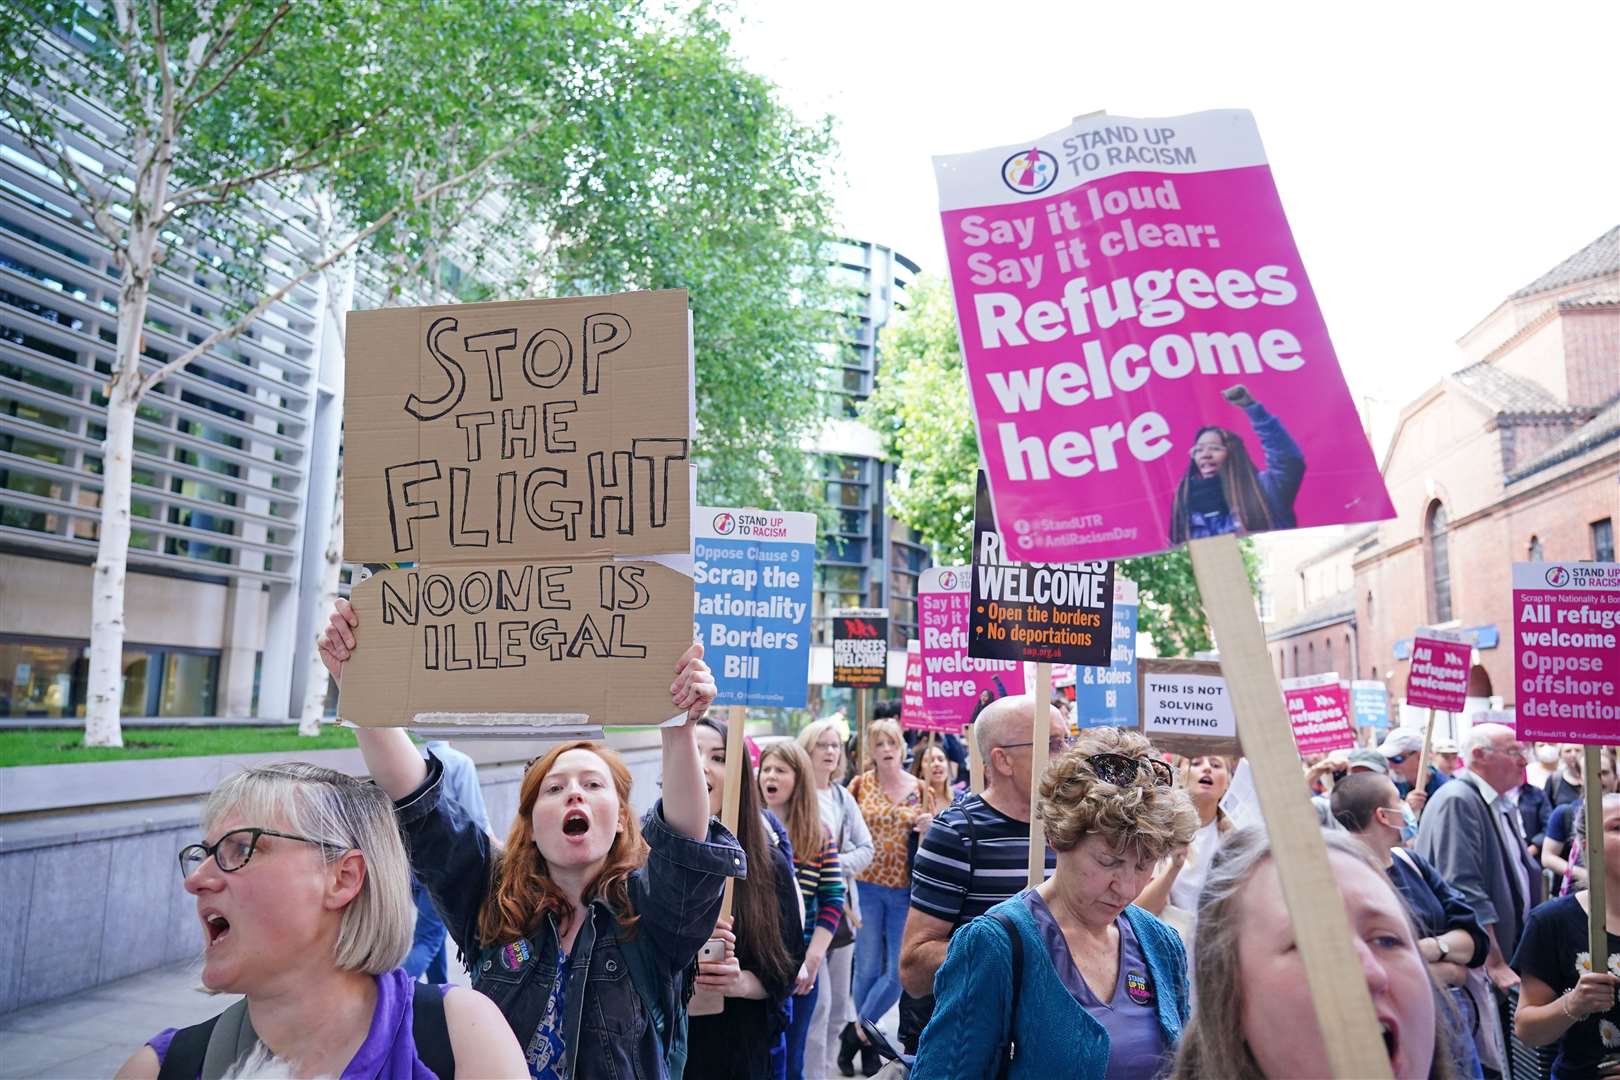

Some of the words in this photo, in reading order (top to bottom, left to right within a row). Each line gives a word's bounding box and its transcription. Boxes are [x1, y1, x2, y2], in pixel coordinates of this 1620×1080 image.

[1062, 125, 1139, 157] STAND
[1143, 127, 1176, 147] UP
[1067, 152, 1100, 177] TO
[1107, 146, 1198, 167] RACISM
[960, 215, 1035, 249] Say
[1046, 204, 1081, 235] it
[1091, 180, 1182, 222] loud
[966, 252, 1044, 289] Say
[1056, 239, 1091, 275] it
[1099, 219, 1222, 258] clear:
[973, 264, 1298, 349] Refugees
[404, 312, 632, 421] STOP
[986, 328, 1306, 414] welcome
[456, 400, 577, 462] THE
[998, 410, 1173, 481] here
[384, 438, 688, 553] FLIGHT
[738, 515, 768, 527] STAND
[770, 518, 784, 527] UP
[738, 526, 751, 535] TO
[752, 528, 787, 537] RACISM
[695, 544, 744, 561] Oppose
[747, 547, 788, 562] Clause
[790, 549, 800, 562] 9
[694, 561, 758, 592] Scrap
[763, 566, 800, 588] the
[1572, 568, 1605, 578] STAND
[1607, 569, 1620, 578] UP
[1572, 577, 1586, 587] TO
[381, 565, 573, 626] NOONE
[599, 565, 650, 611] IS
[978, 565, 1106, 609] WELCOME
[923, 596, 947, 612] Say
[951, 595, 961, 609] it
[1520, 593, 1543, 603] Scrap
[1545, 594, 1557, 603] the
[1558, 594, 1599, 605] Nationality
[923, 611, 948, 628] Say
[952, 611, 962, 624] it
[988, 602, 1022, 625] Open
[1027, 605, 1049, 622] the
[1052, 607, 1101, 627] borders
[1521, 604, 1551, 624] All
[424, 614, 647, 671] ILLEGAL
[710, 624, 799, 650] Borders
[987, 622, 1006, 640] No
[1010, 624, 1092, 646] deportations
[1521, 628, 1616, 648] welcome
[834, 653, 887, 668] WELCOME
[925, 651, 1017, 673] welcome
[1414, 647, 1432, 661] All
[1521, 650, 1604, 675] Oppose
[724, 655, 760, 679] Bill
[1083, 666, 1094, 685] &
[1412, 662, 1465, 680] refugees
[926, 675, 977, 698] here
[1150, 684, 1179, 694] THIS
[1183, 685, 1195, 695] IS
[1198, 686, 1223, 696] NOT
[1410, 675, 1467, 693] welcome!
[1522, 674, 1615, 696] offshore
[1159, 699, 1214, 712] SOLVING
[1288, 698, 1305, 711] All
[1291, 707, 1343, 723] refugees
[1153, 716, 1218, 728] ANYTHING
